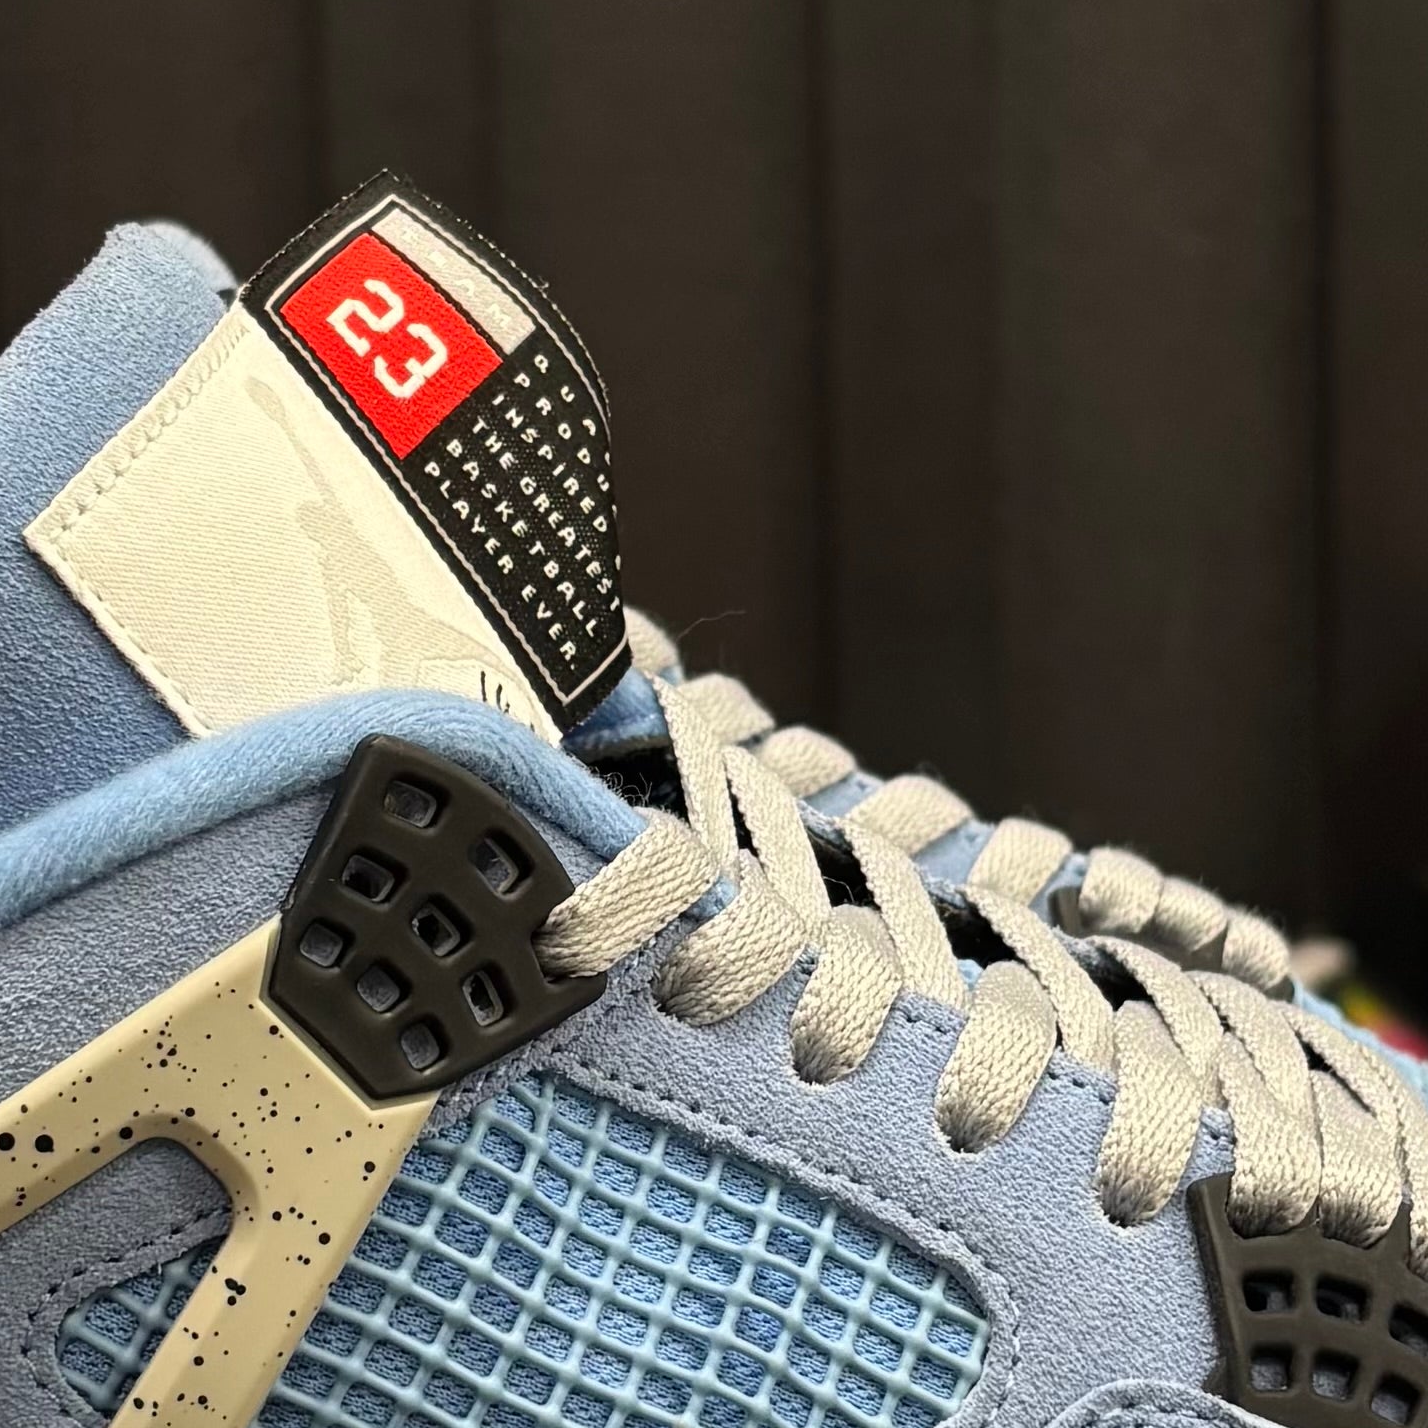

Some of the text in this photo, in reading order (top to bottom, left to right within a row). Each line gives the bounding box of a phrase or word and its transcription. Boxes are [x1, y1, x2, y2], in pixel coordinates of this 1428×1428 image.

[325, 278, 448, 399] 23
[445, 438, 598, 638] BASKETBALL
[472, 414, 621, 612] THE GREATEST
[491, 392, 608, 533] INSPIRED
[423, 460, 576, 671] PLAYER EVER.
